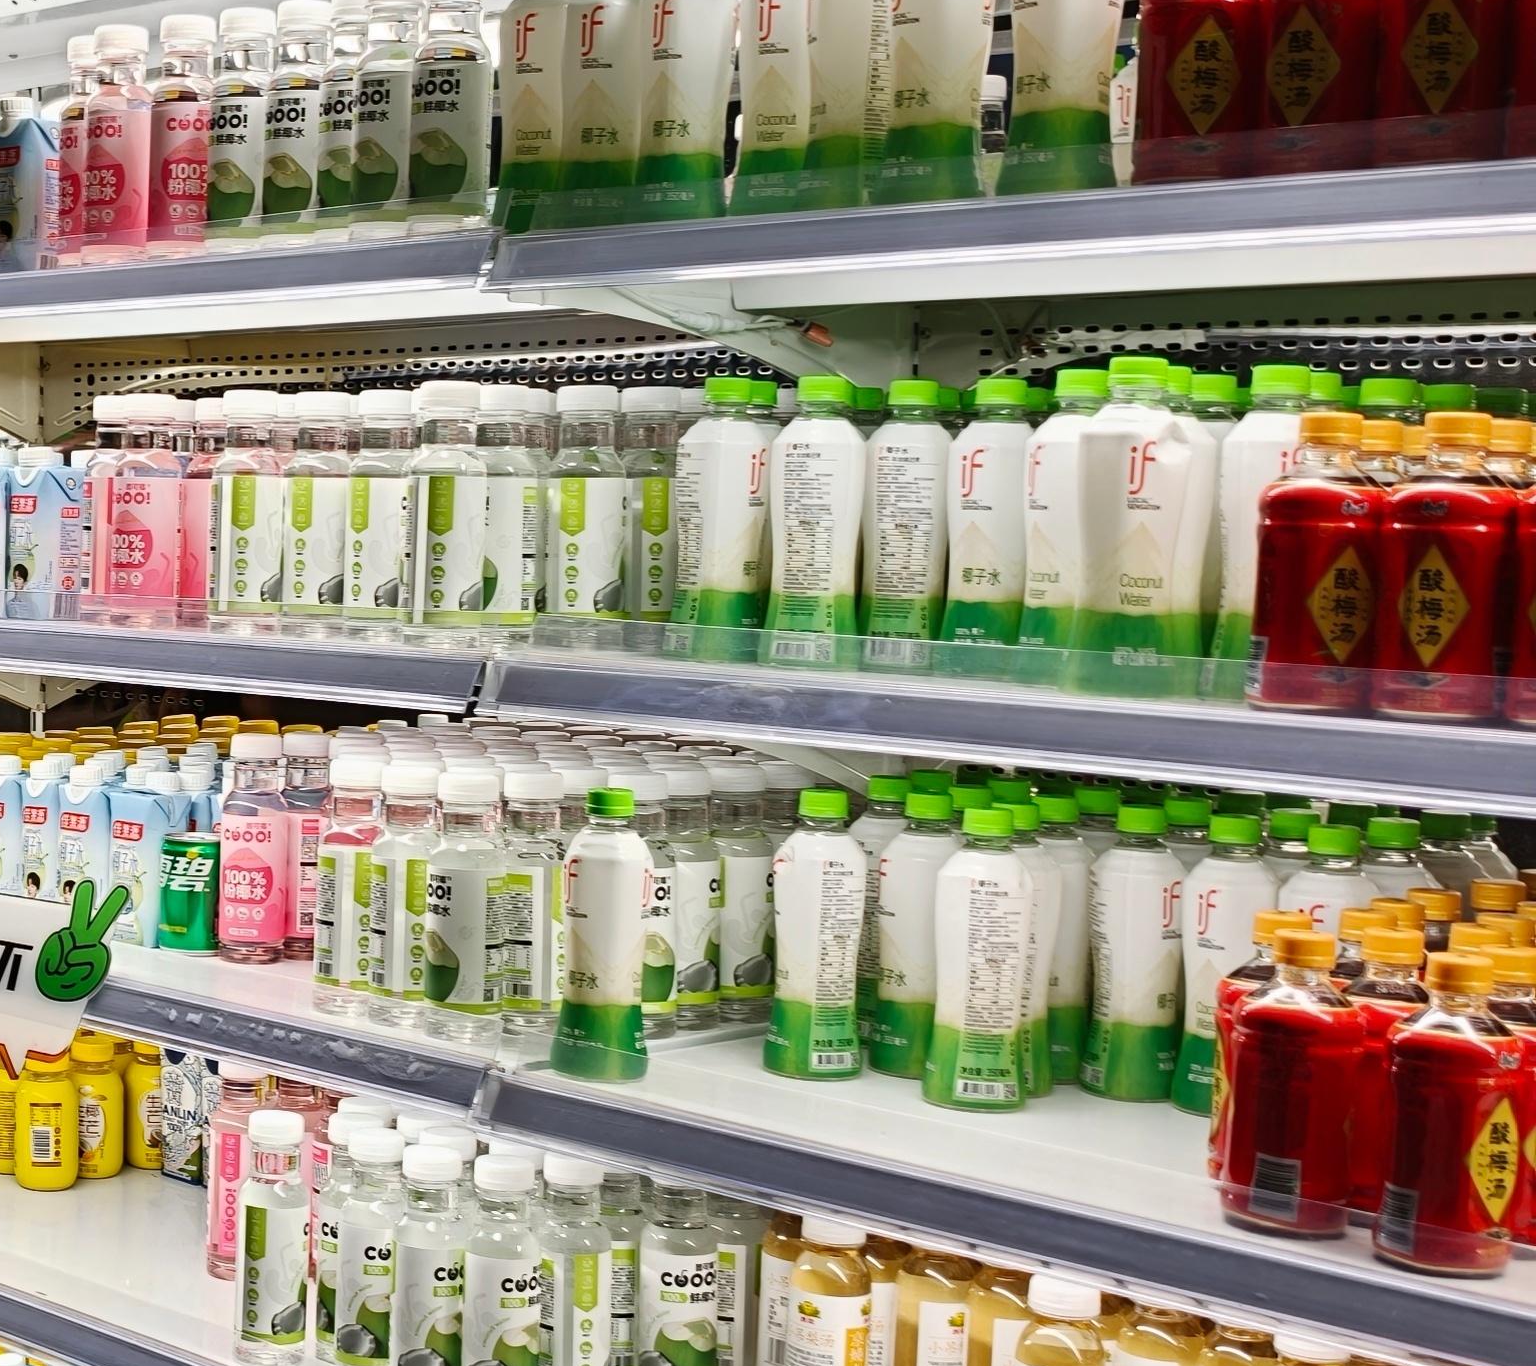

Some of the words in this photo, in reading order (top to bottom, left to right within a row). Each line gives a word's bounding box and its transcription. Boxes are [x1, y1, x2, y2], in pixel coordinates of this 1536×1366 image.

[516, 13, 537, 62] if
[581, 5, 604, 57] if
[1424, 10, 1455, 92] 酸梅汤
[1189, 39, 1220, 116] 酸梅汤
[1286, 30, 1316, 109] 酸梅汤
[581, 127, 619, 144] 椰子水
[653, 119, 690, 137] 椰子水
[756, 113, 796, 127] Coconut
[751, 448, 766, 496] if
[961, 447, 985, 497] if
[1127, 441, 1156, 495] if
[962, 567, 1001, 586] 椰子水
[1119, 572, 1164, 590] Coconut
[1119, 591, 1154, 607] Water
[1330, 567, 1362, 645] 酸梅汤
[1415, 567, 1447, 648] 酸梅汤
[224, 869, 267, 885] 100%
[224, 884, 267, 901] 粉椰水
[1163, 881, 1182, 928] if
[1197, 889, 1220, 935] if
[1487, 1122, 1512, 1201] 酸梅汤
